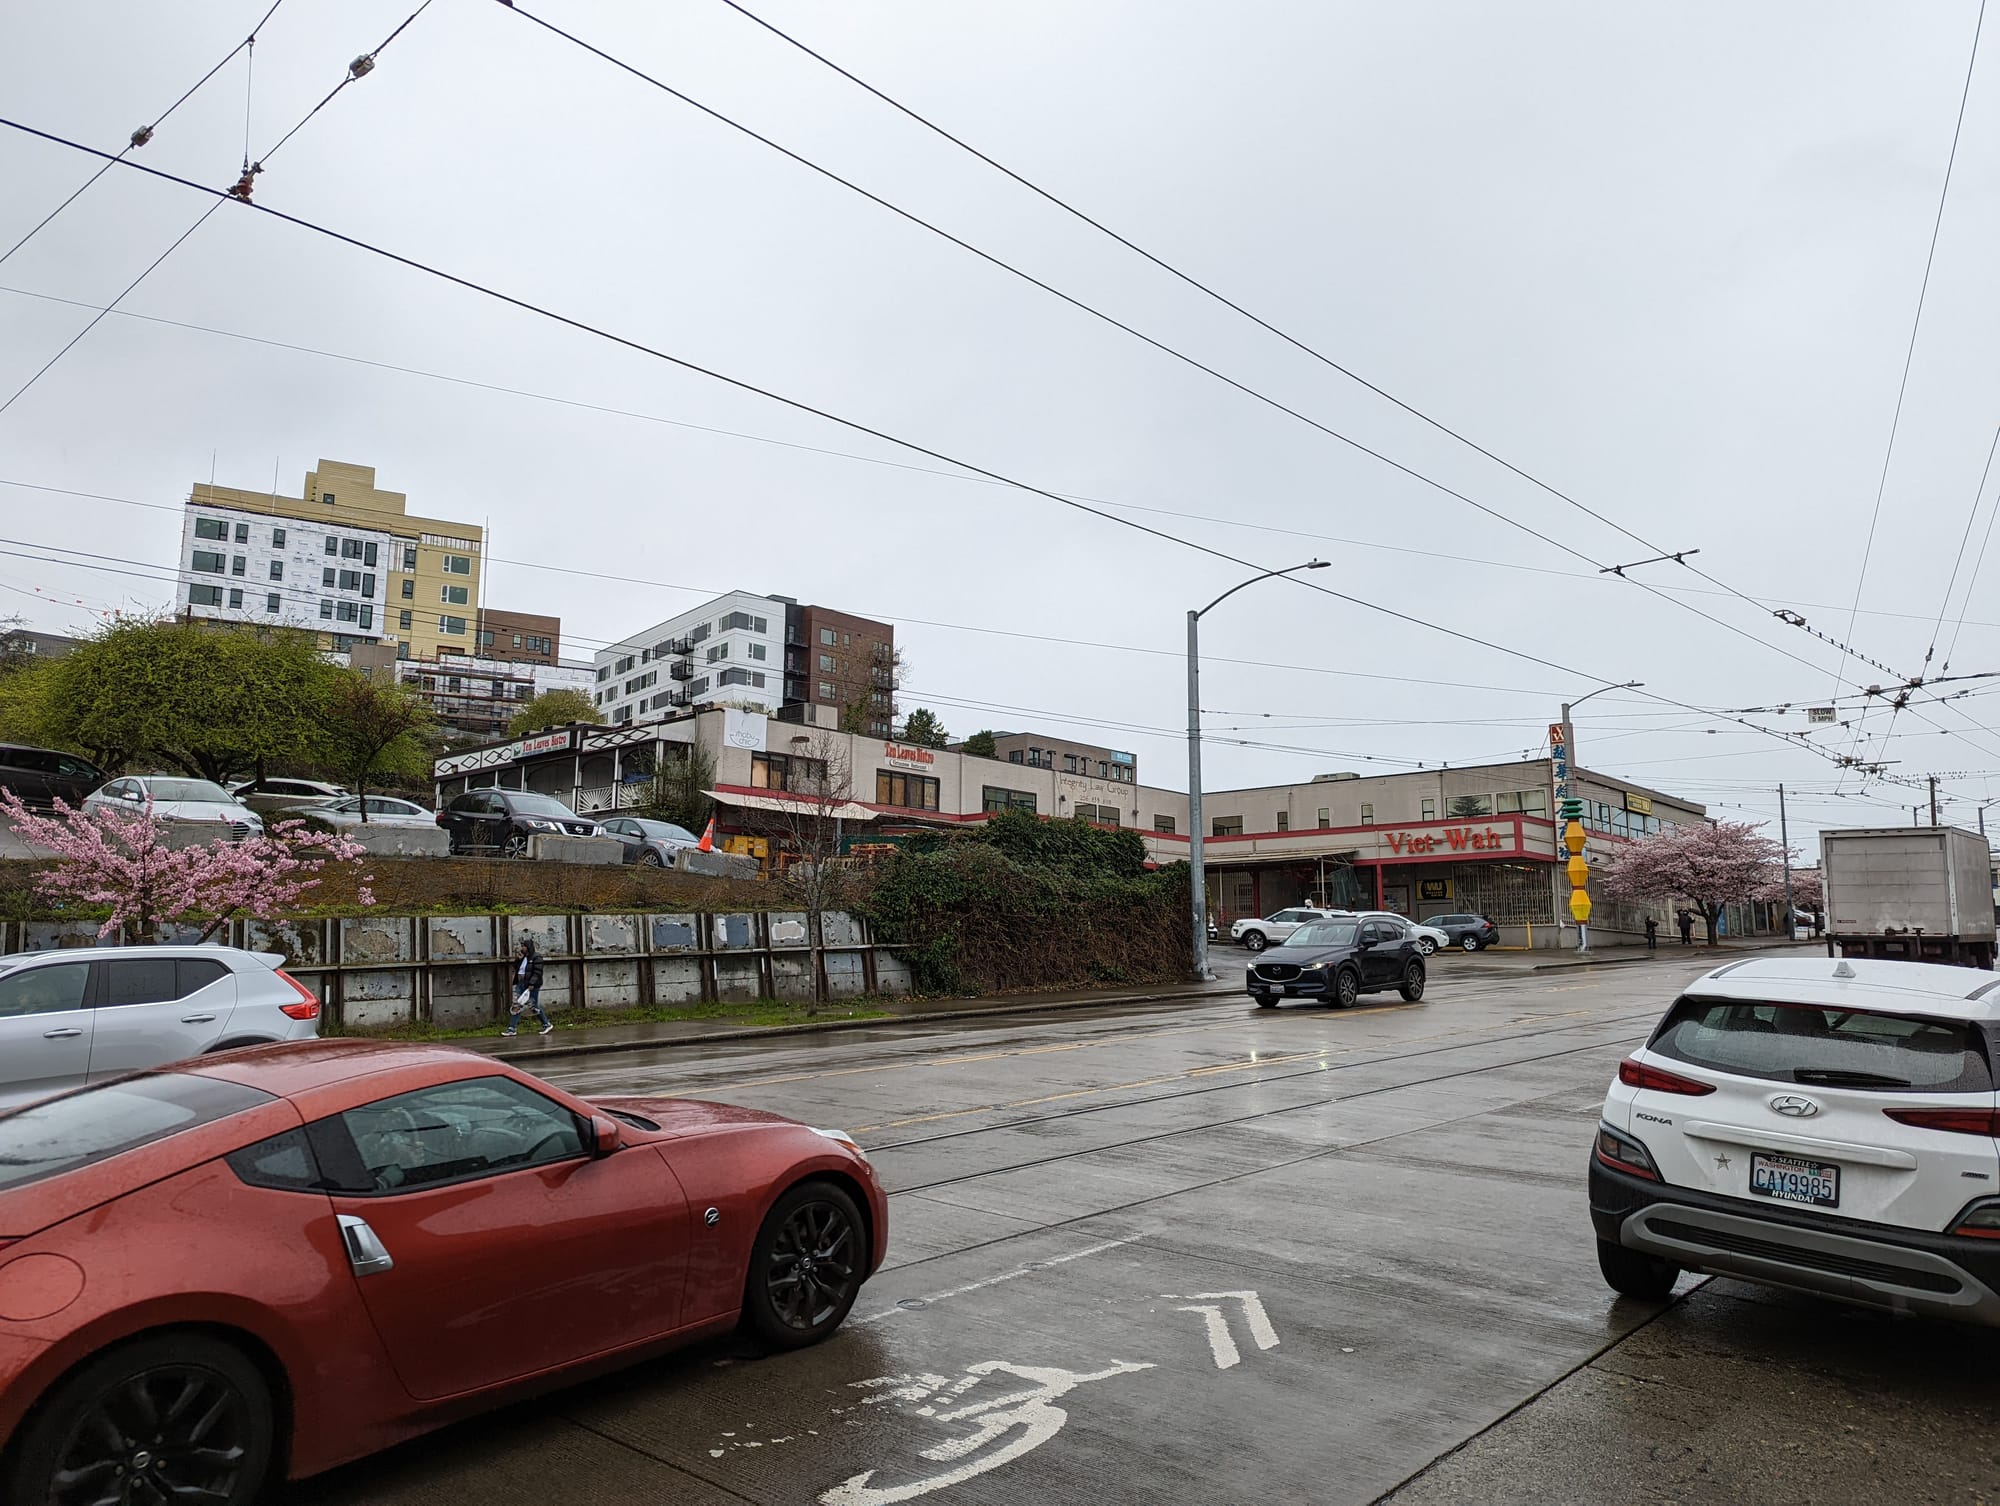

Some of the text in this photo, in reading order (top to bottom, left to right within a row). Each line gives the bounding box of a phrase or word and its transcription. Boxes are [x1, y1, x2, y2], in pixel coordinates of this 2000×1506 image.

[523, 741, 533, 753] Ten
[534, 739, 551, 750] Leaves
[552, 735, 567, 747] Bistro
[885, 742, 896, 758] Ten
[896, 743, 916, 761] Leaves
[1059, 772, 1129, 800] Integrity Law Group
[1384, 826, 1502, 855] Viet-Wah
[1636, 1112, 1673, 1126] KONA
[1758, 1160, 1805, 1173] WASHINGTON
[1778, 1156, 1811, 1168] SEATTLE
[1756, 1168, 1832, 1199] CAY9985
[1771, 1189, 1815, 1204] HYUNDAI
